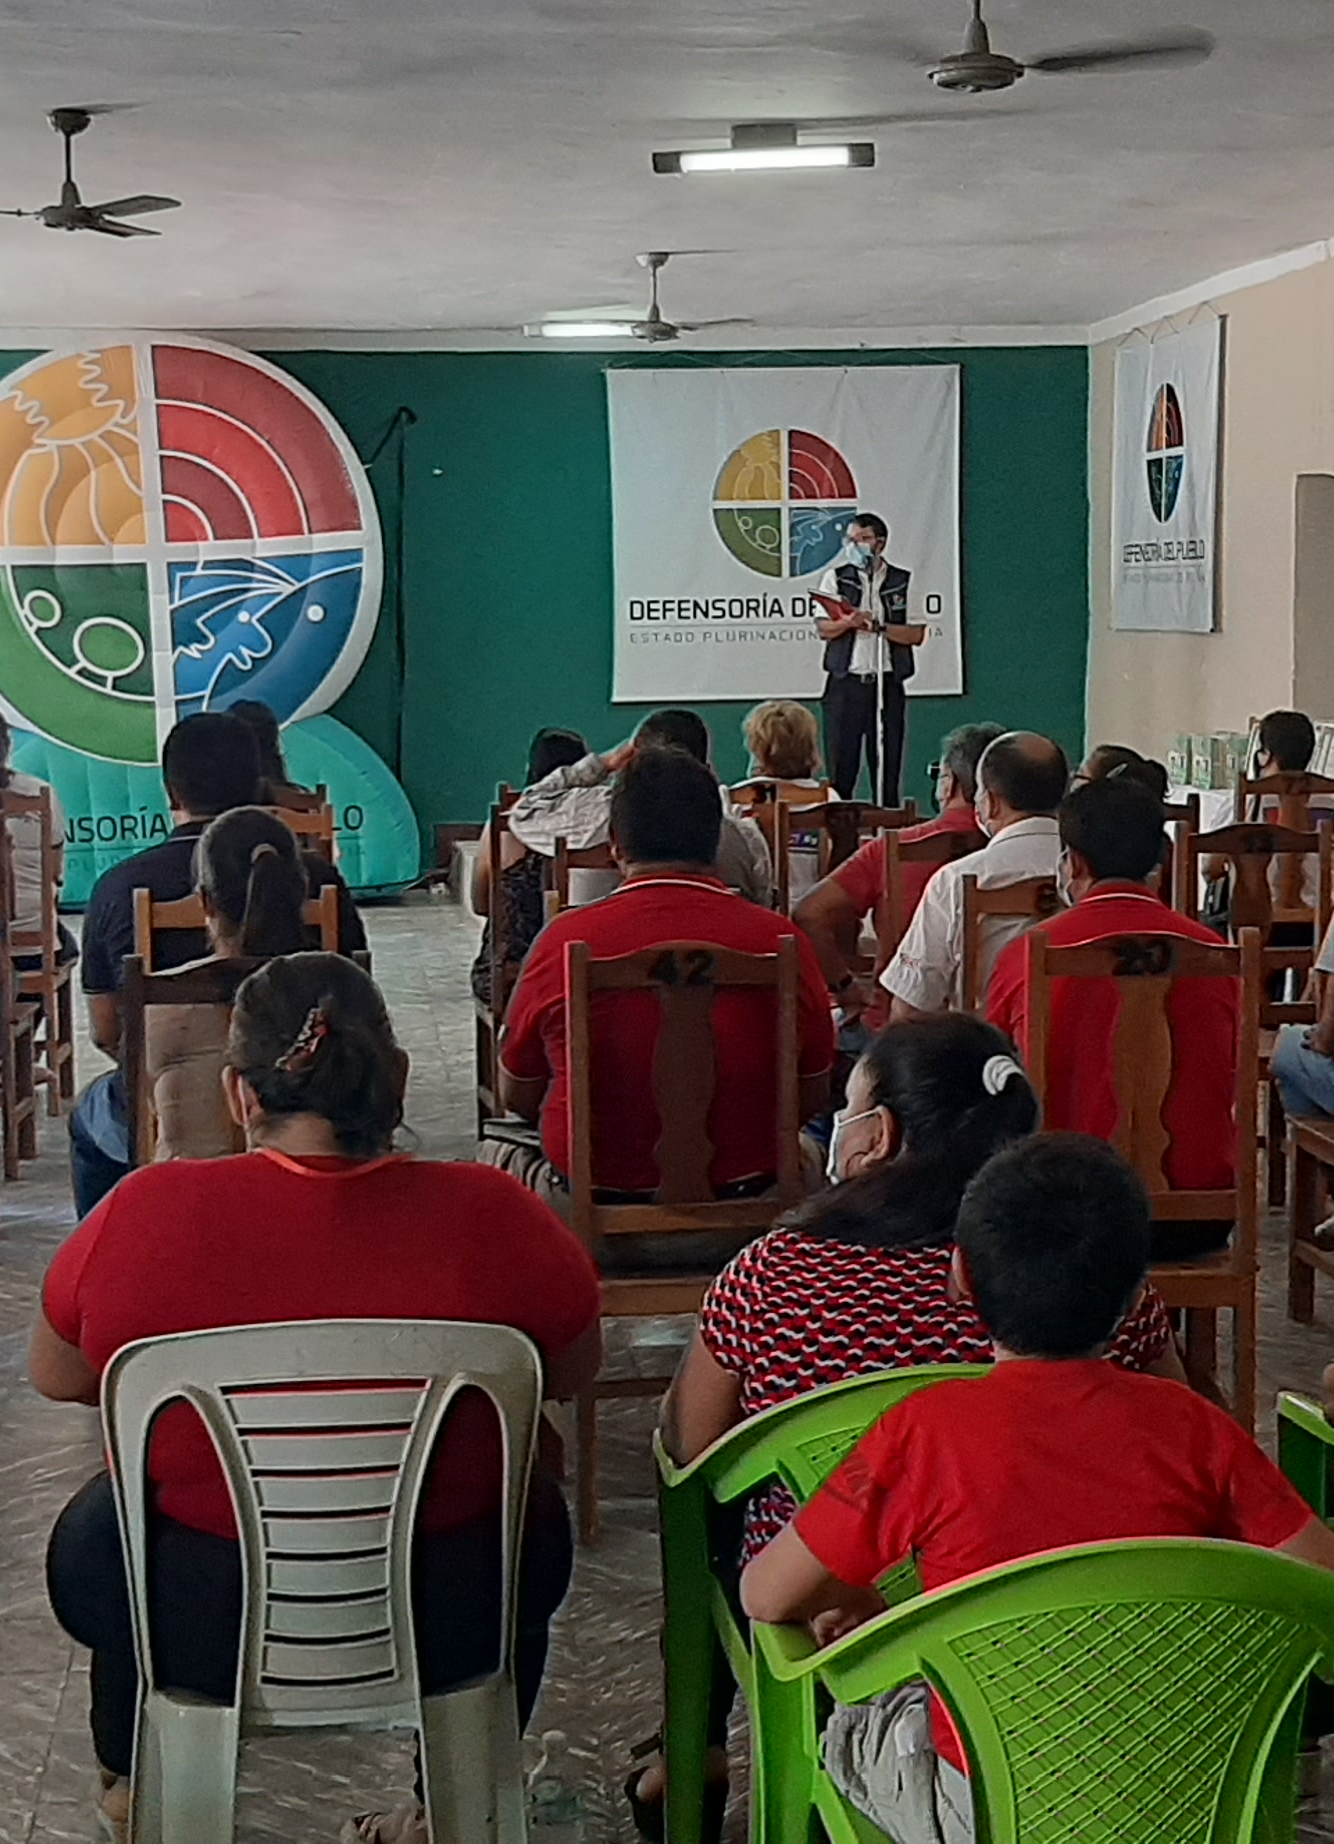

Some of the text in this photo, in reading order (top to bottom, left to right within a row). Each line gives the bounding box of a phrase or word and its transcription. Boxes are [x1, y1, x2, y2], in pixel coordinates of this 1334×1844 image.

[629, 593, 818, 621] DEFENSORÍA DE
[702, 625, 818, 642] PLURINACION
[647, 949, 715, 985] 42
